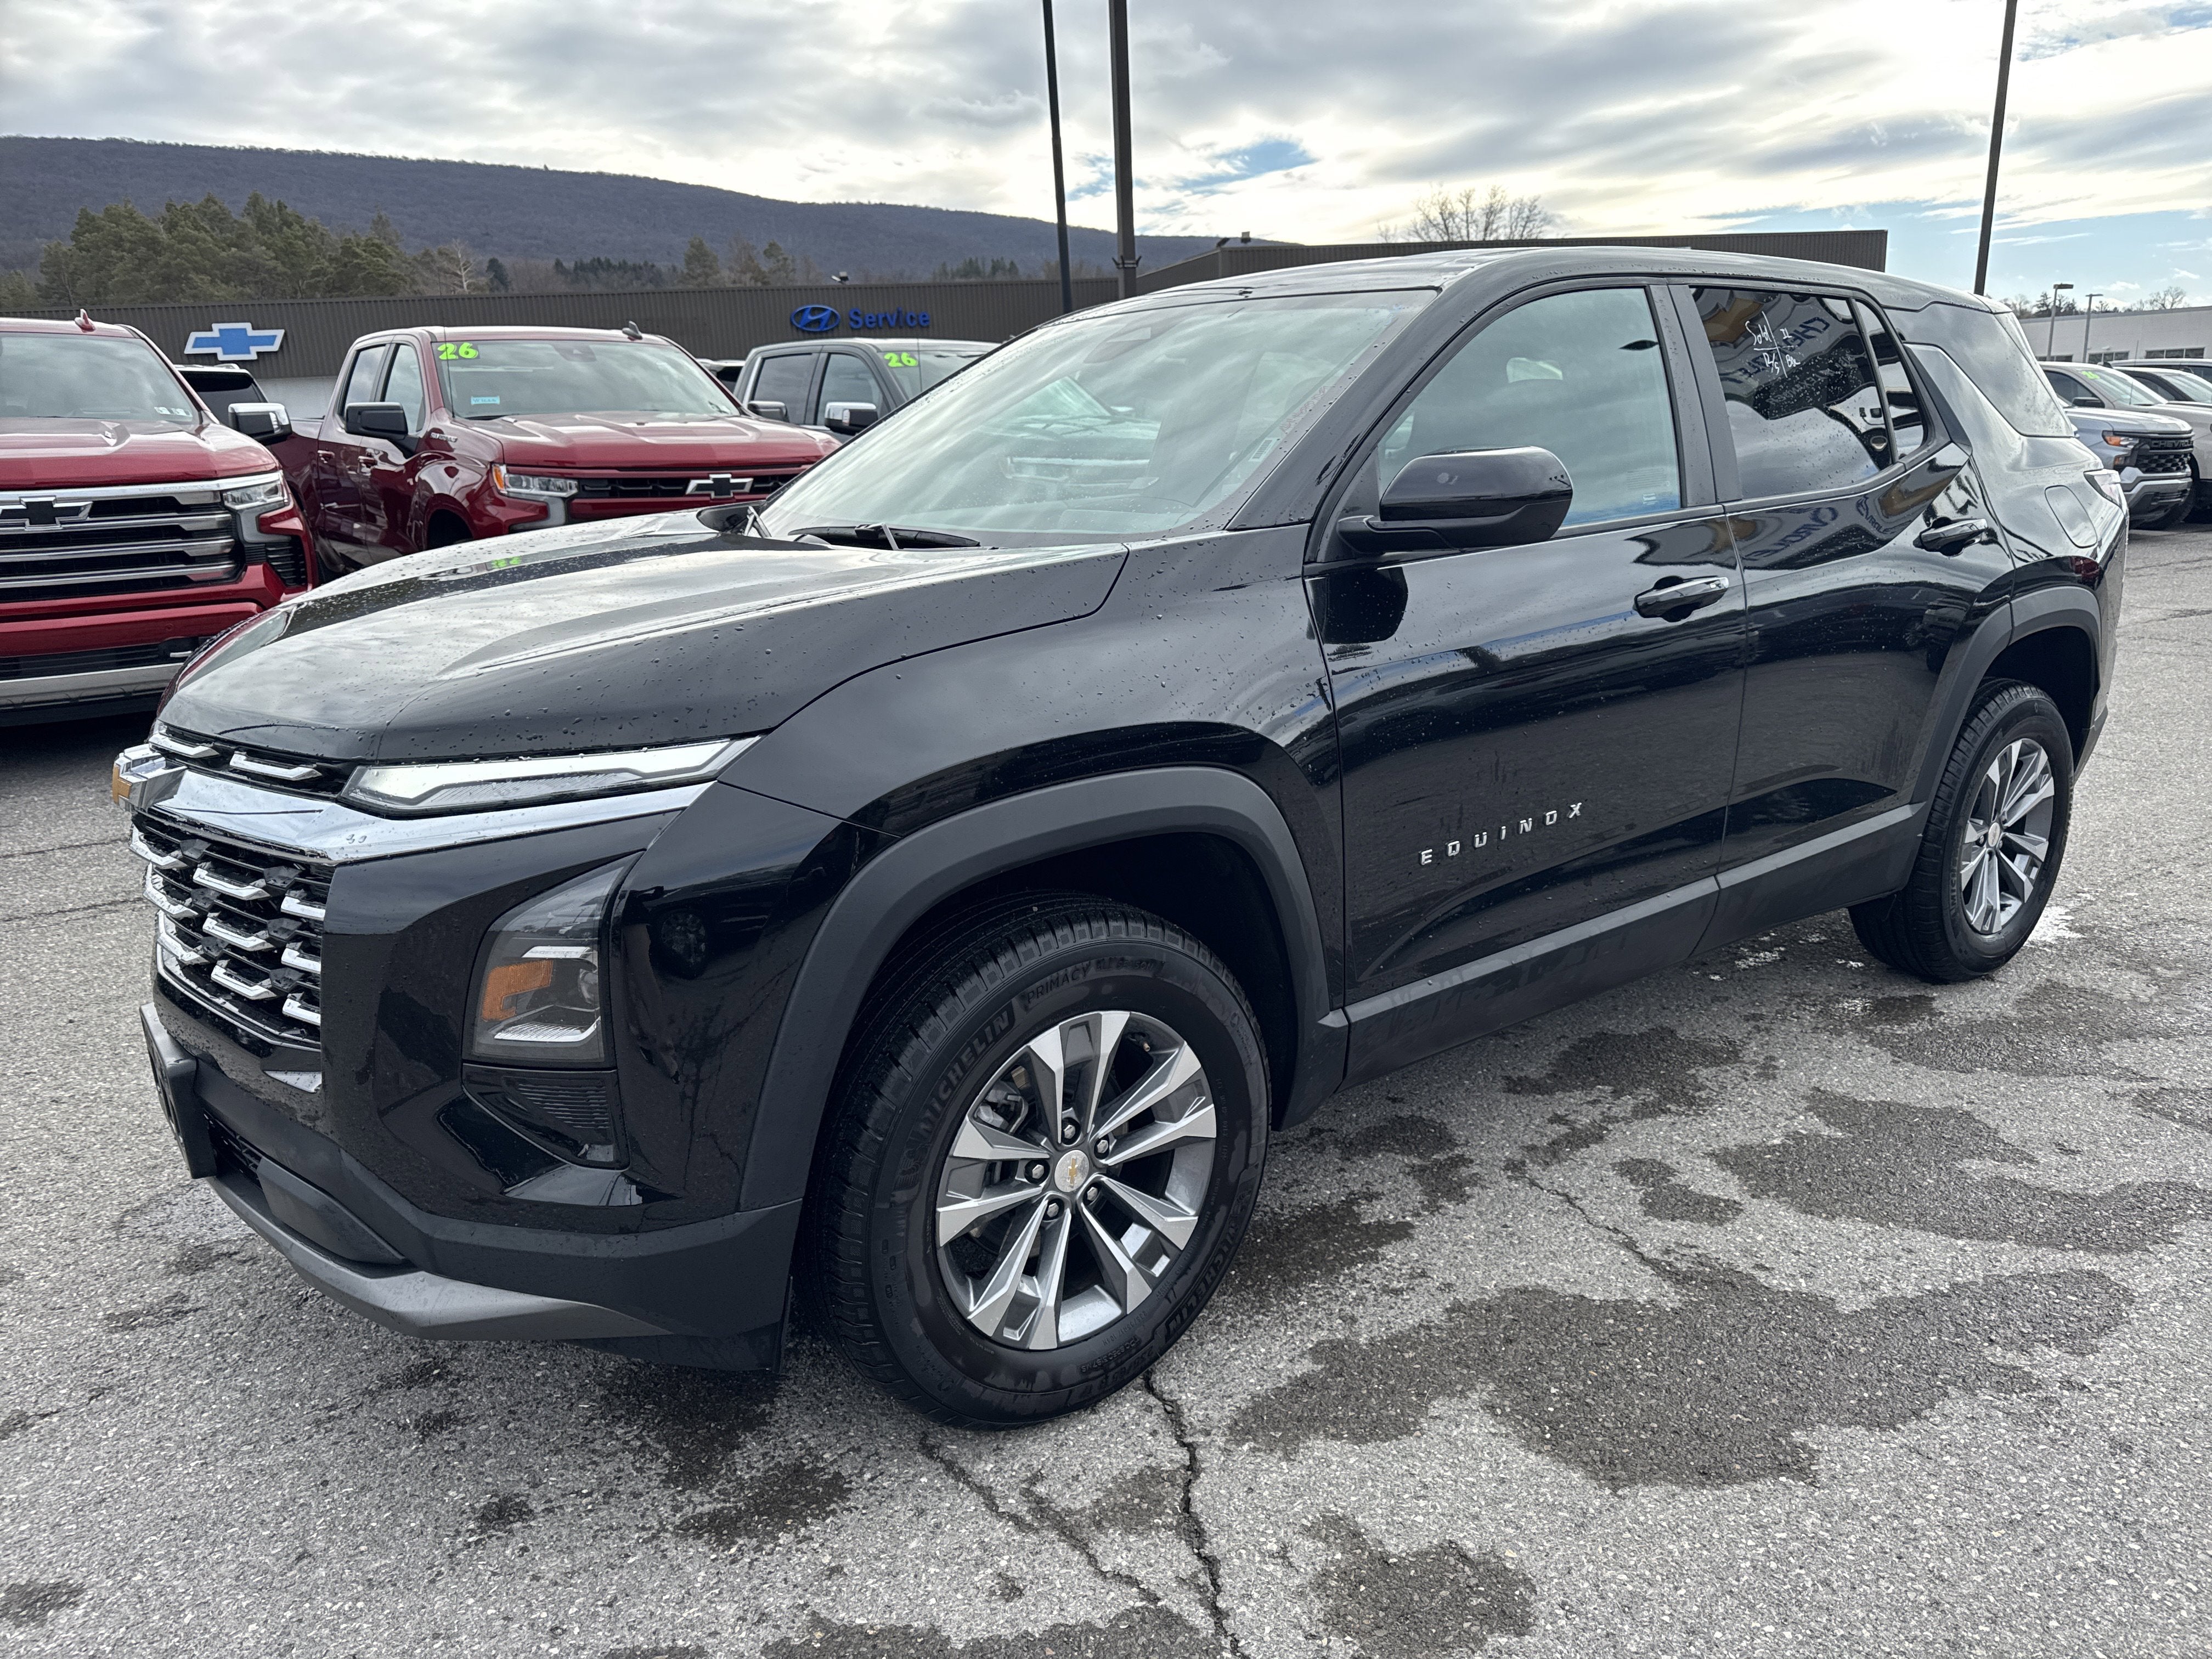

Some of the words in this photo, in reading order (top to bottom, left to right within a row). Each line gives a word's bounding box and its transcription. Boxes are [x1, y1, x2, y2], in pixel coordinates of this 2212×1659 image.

[849, 307, 930, 329] Service
[1745, 321, 1772, 345] Sold
[437, 342, 478, 360] 26
[884, 352, 918, 367] 26
[1419, 802, 1582, 866] EQUINOX
[1116, 961, 1154, 970] SESON
[1028, 961, 1091, 1003] PRIMACY
[919, 1011, 1009, 1132] MICHELIN
